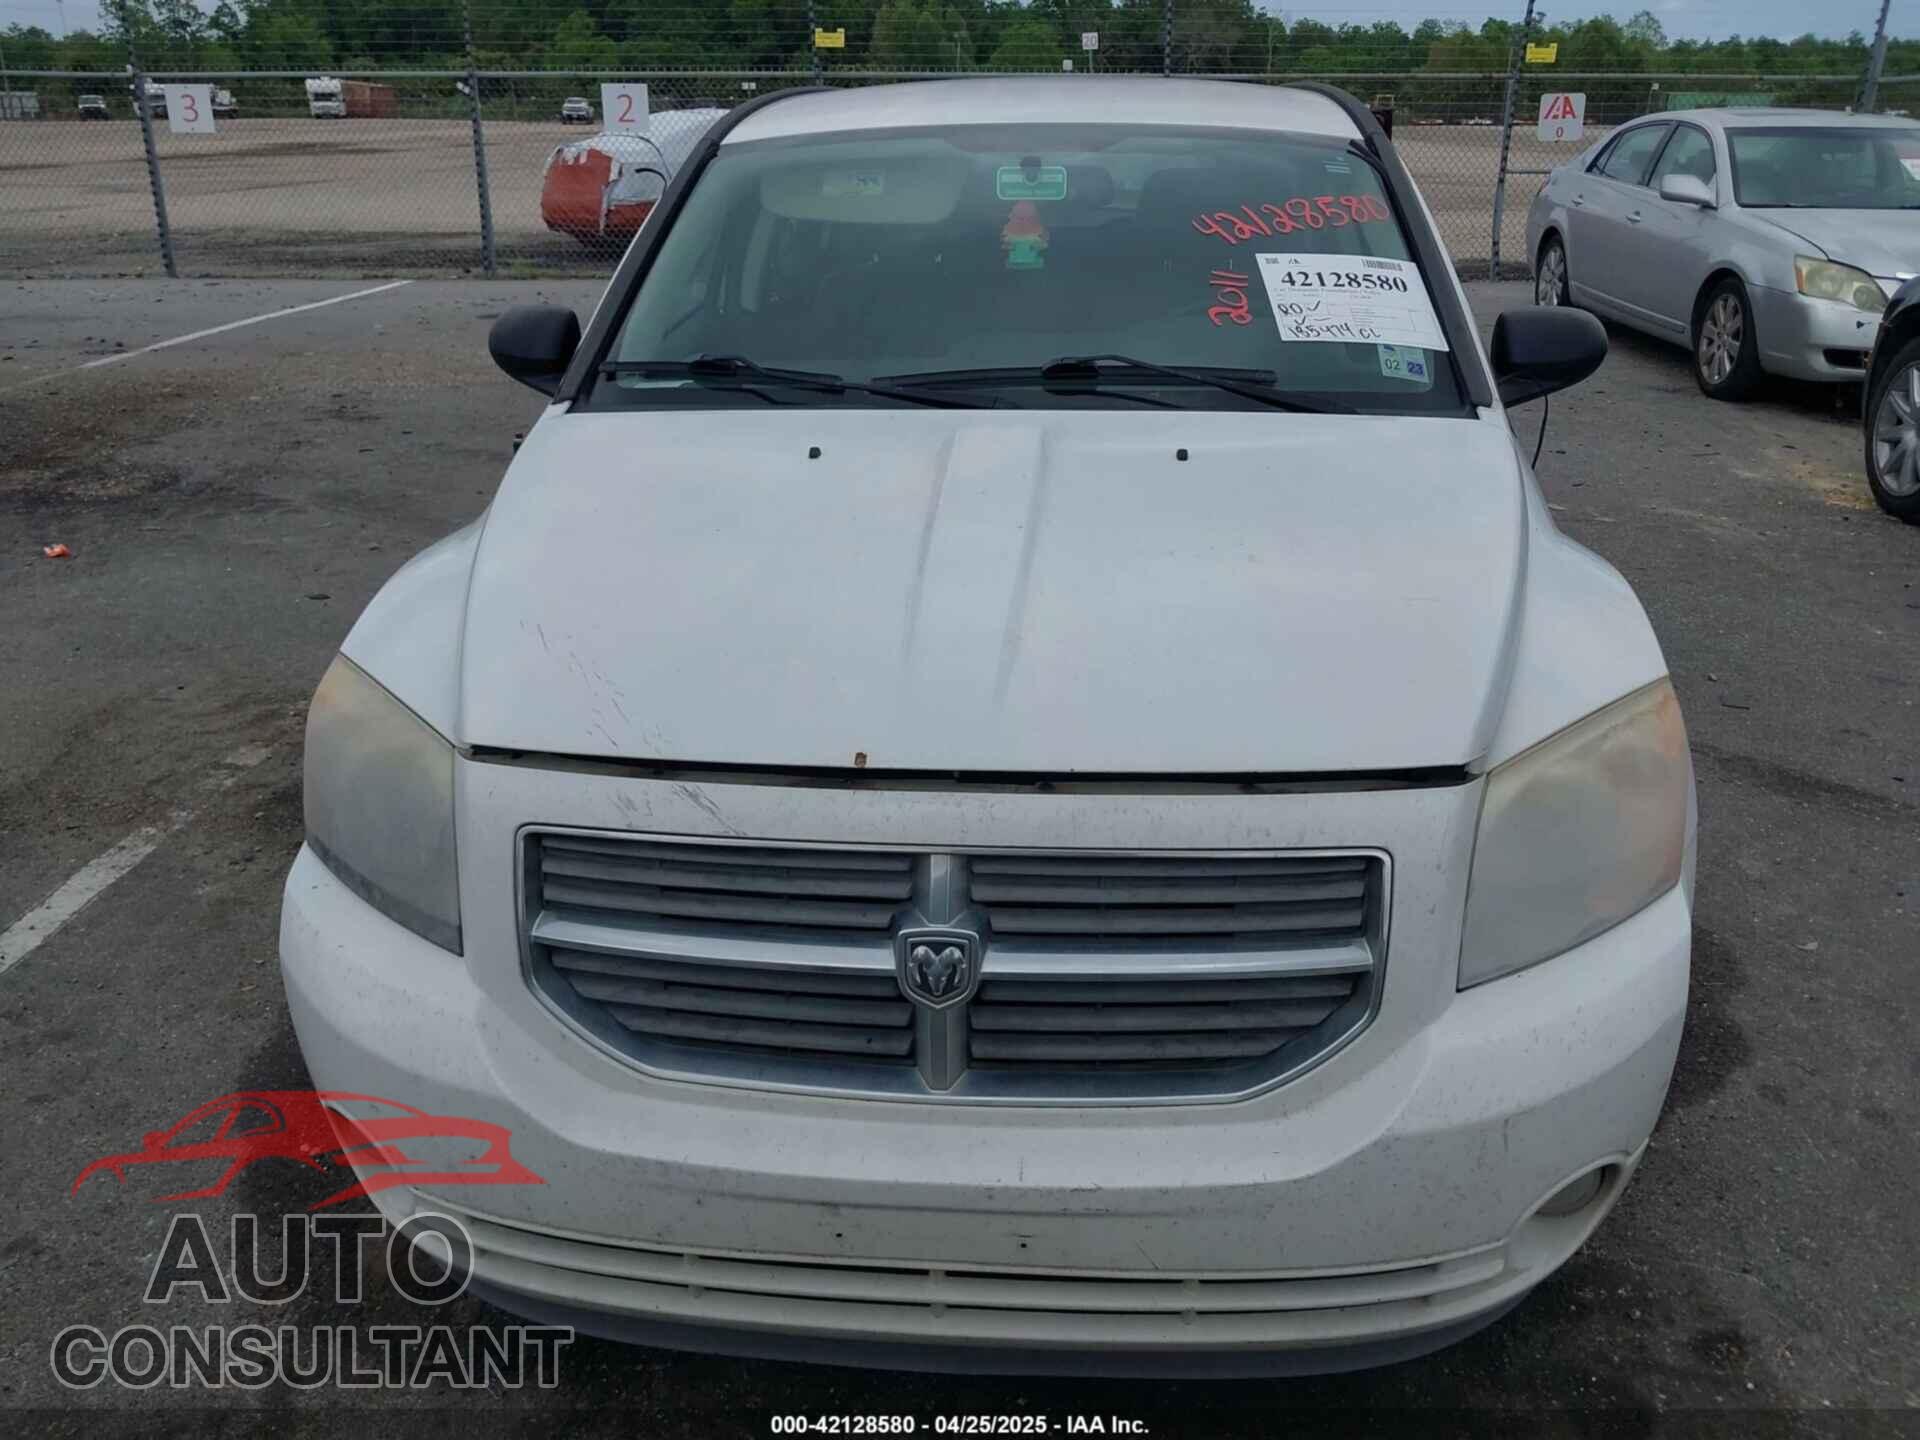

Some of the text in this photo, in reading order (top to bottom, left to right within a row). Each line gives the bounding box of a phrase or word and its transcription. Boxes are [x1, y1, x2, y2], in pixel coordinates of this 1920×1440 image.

[181, 93, 199, 122] 3
[616, 93, 635, 122] 2
[1192, 194, 1391, 245] 42128580
[1281, 270, 1408, 293] 42128580
[1385, 358, 1424, 376] 02 23
